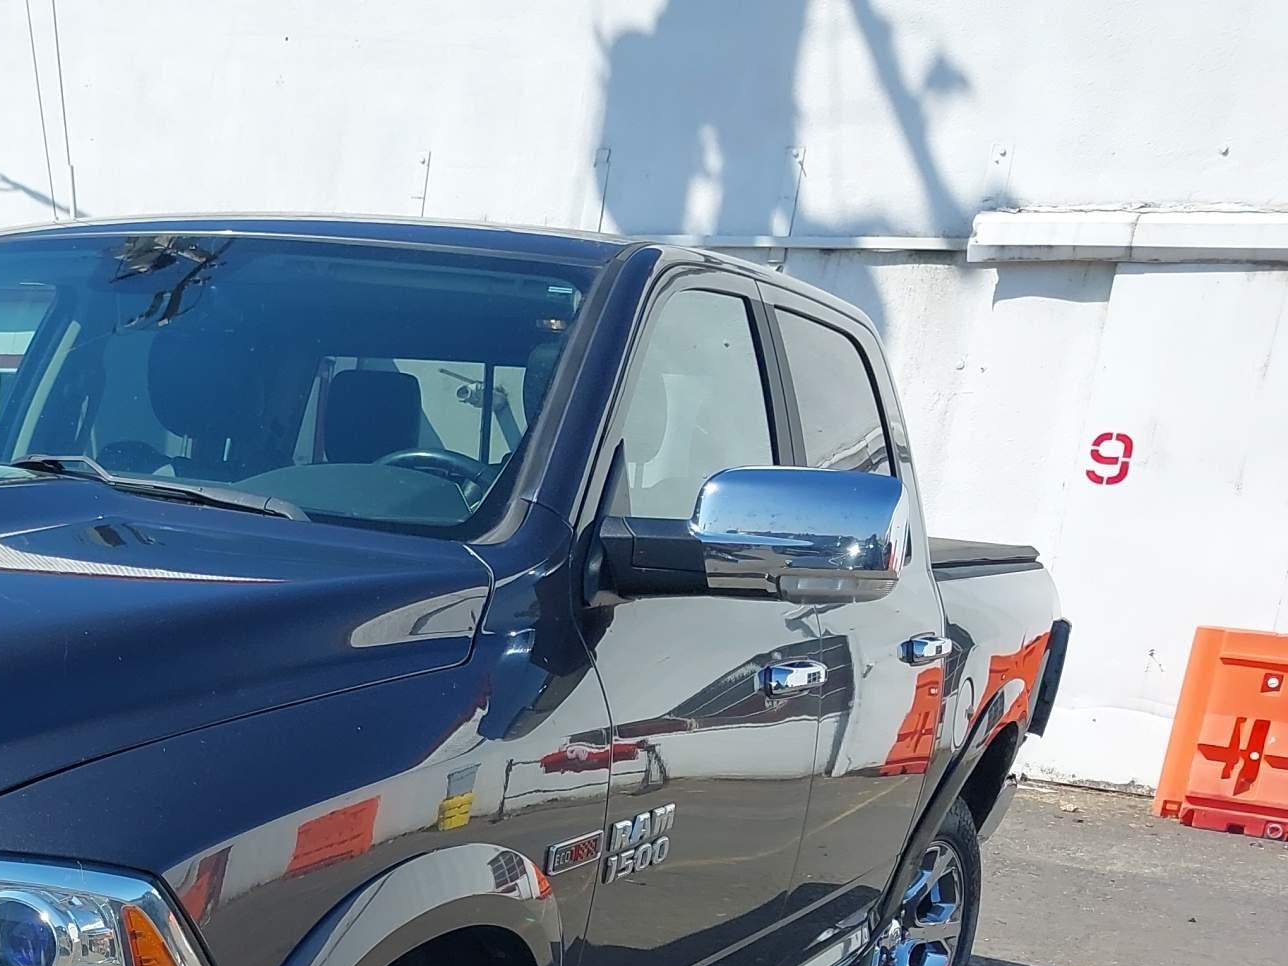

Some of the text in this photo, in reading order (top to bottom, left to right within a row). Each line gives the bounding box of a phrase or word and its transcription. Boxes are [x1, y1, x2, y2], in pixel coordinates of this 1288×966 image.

[1085, 432, 1135, 486] 9
[611, 803, 676, 850] RAM
[605, 836, 670, 885] 1500
